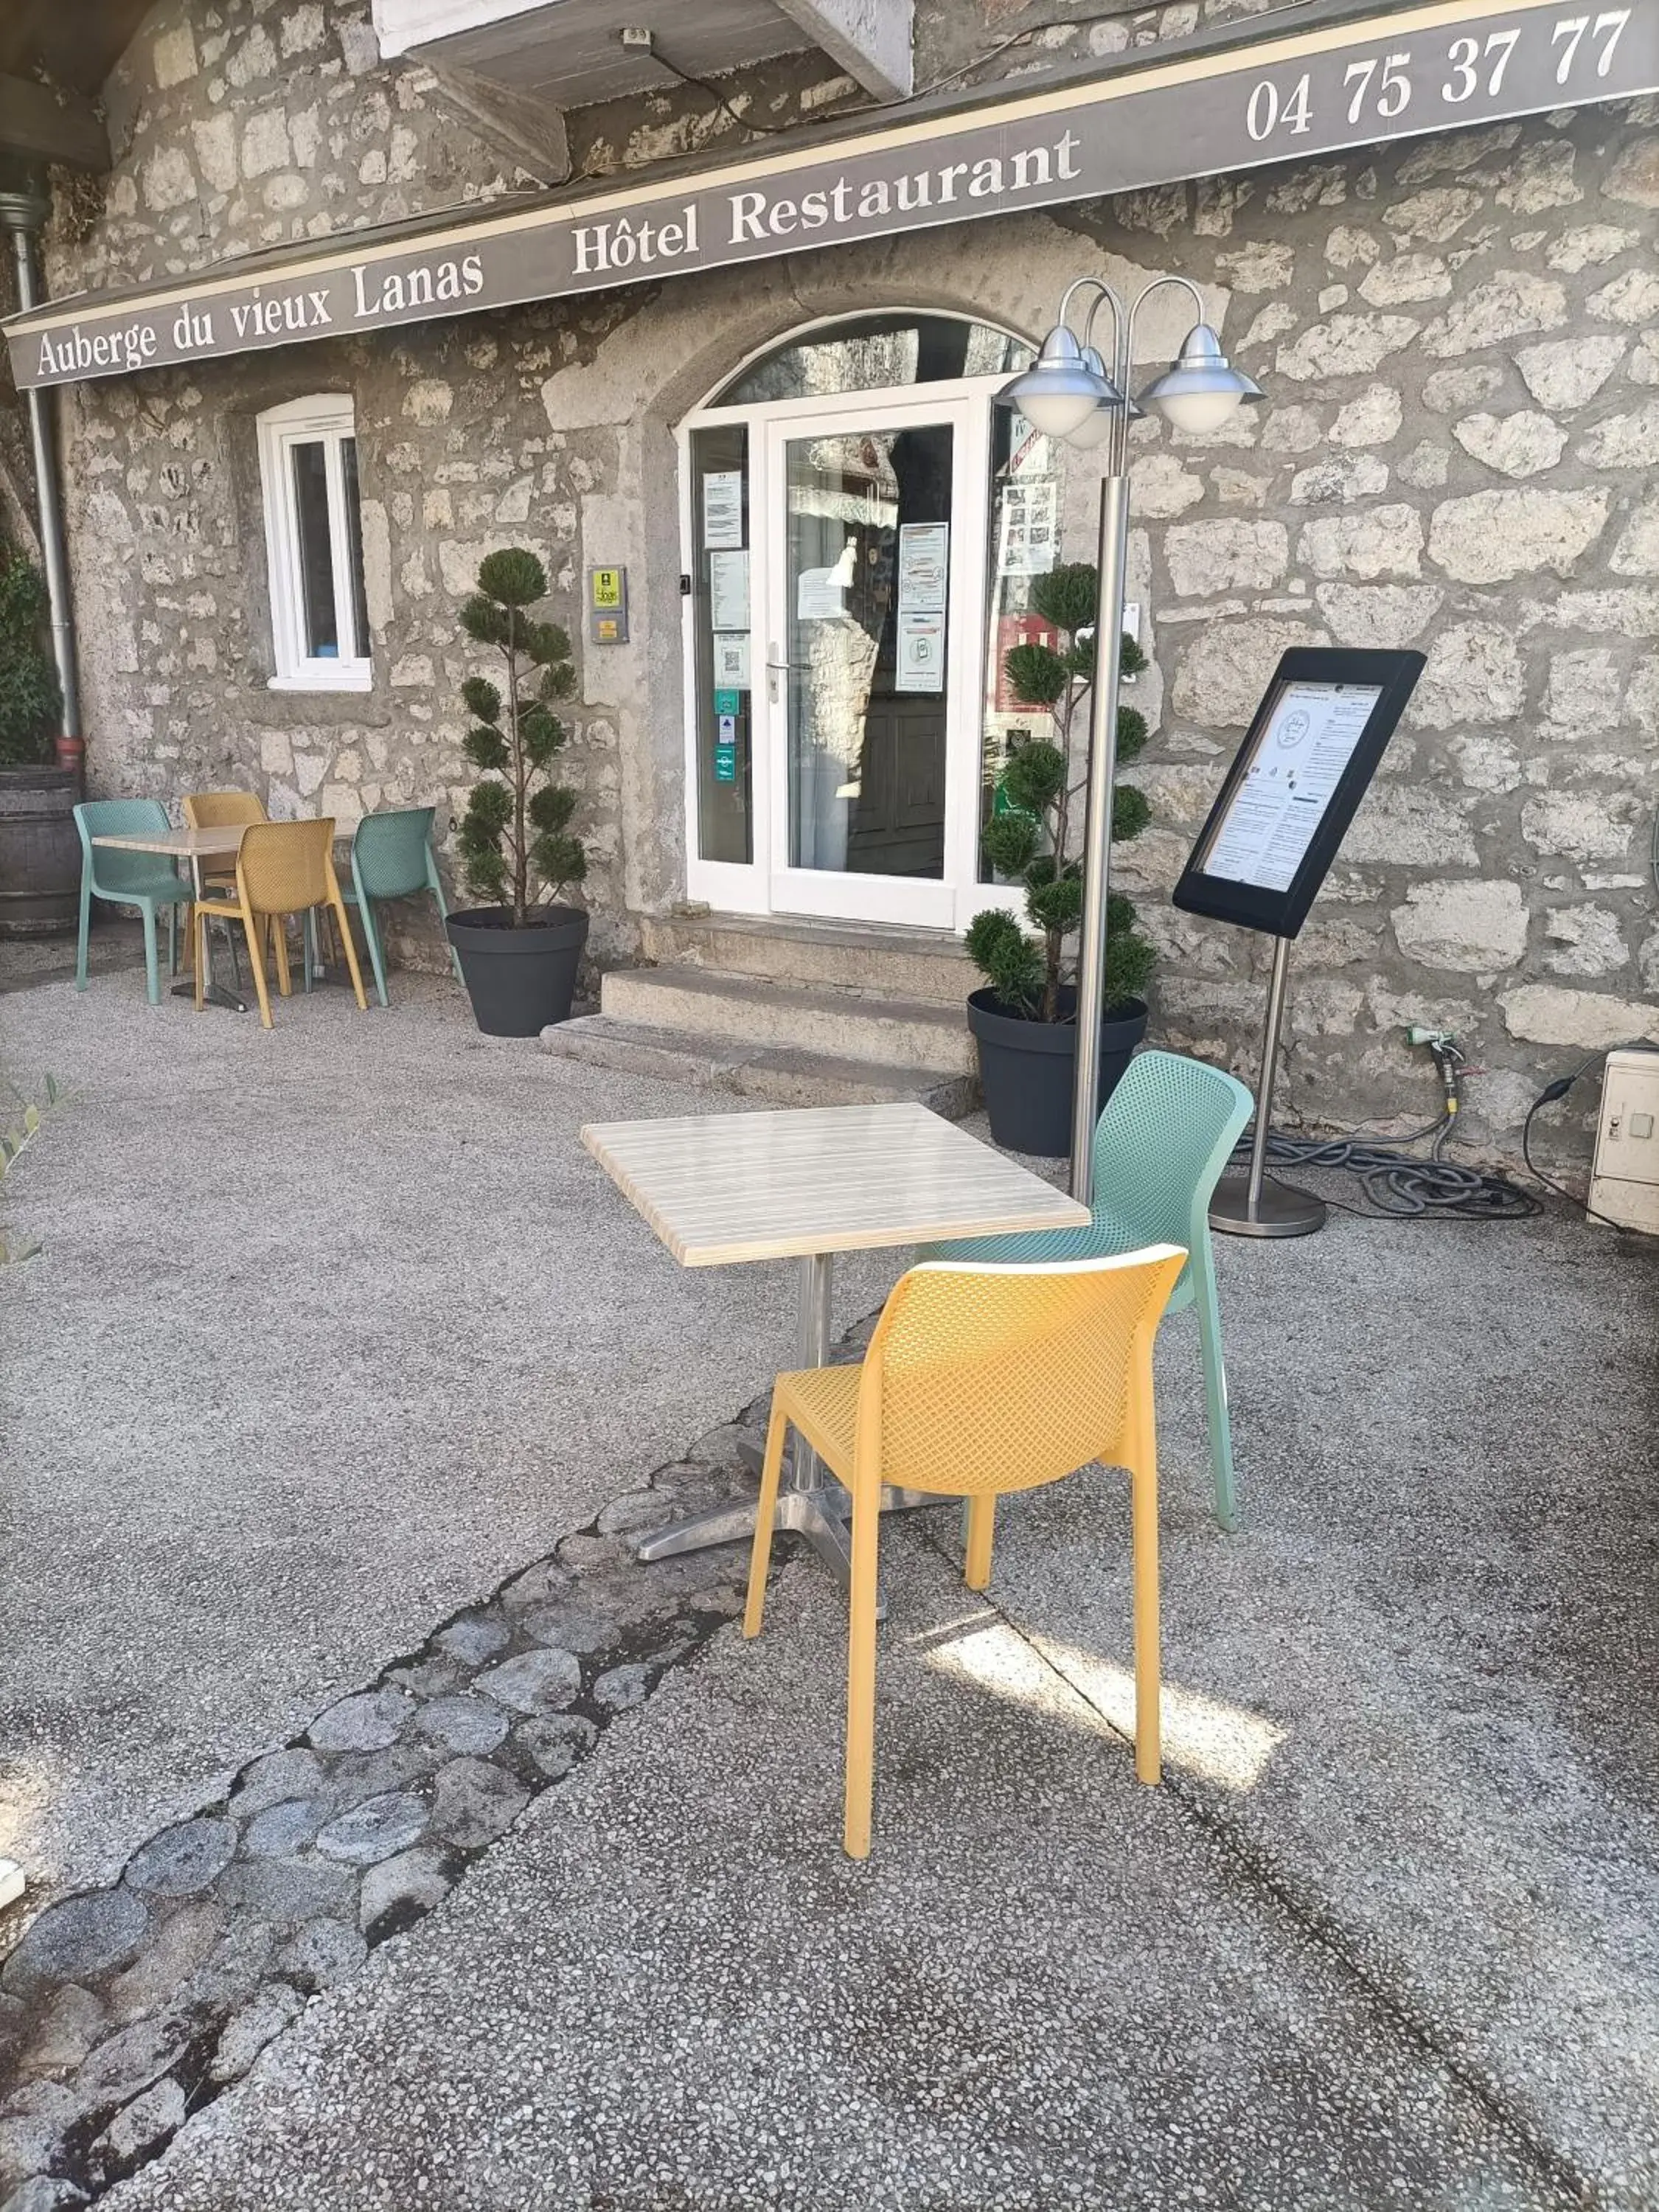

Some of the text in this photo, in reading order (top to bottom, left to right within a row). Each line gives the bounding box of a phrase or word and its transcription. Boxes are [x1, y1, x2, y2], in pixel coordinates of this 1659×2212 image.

[1246, 9, 1632, 141] 04 75 37 77
[571, 129, 1082, 276] Hôtel Restaurant
[36, 254, 484, 375] Auberge du vieux Lanas
